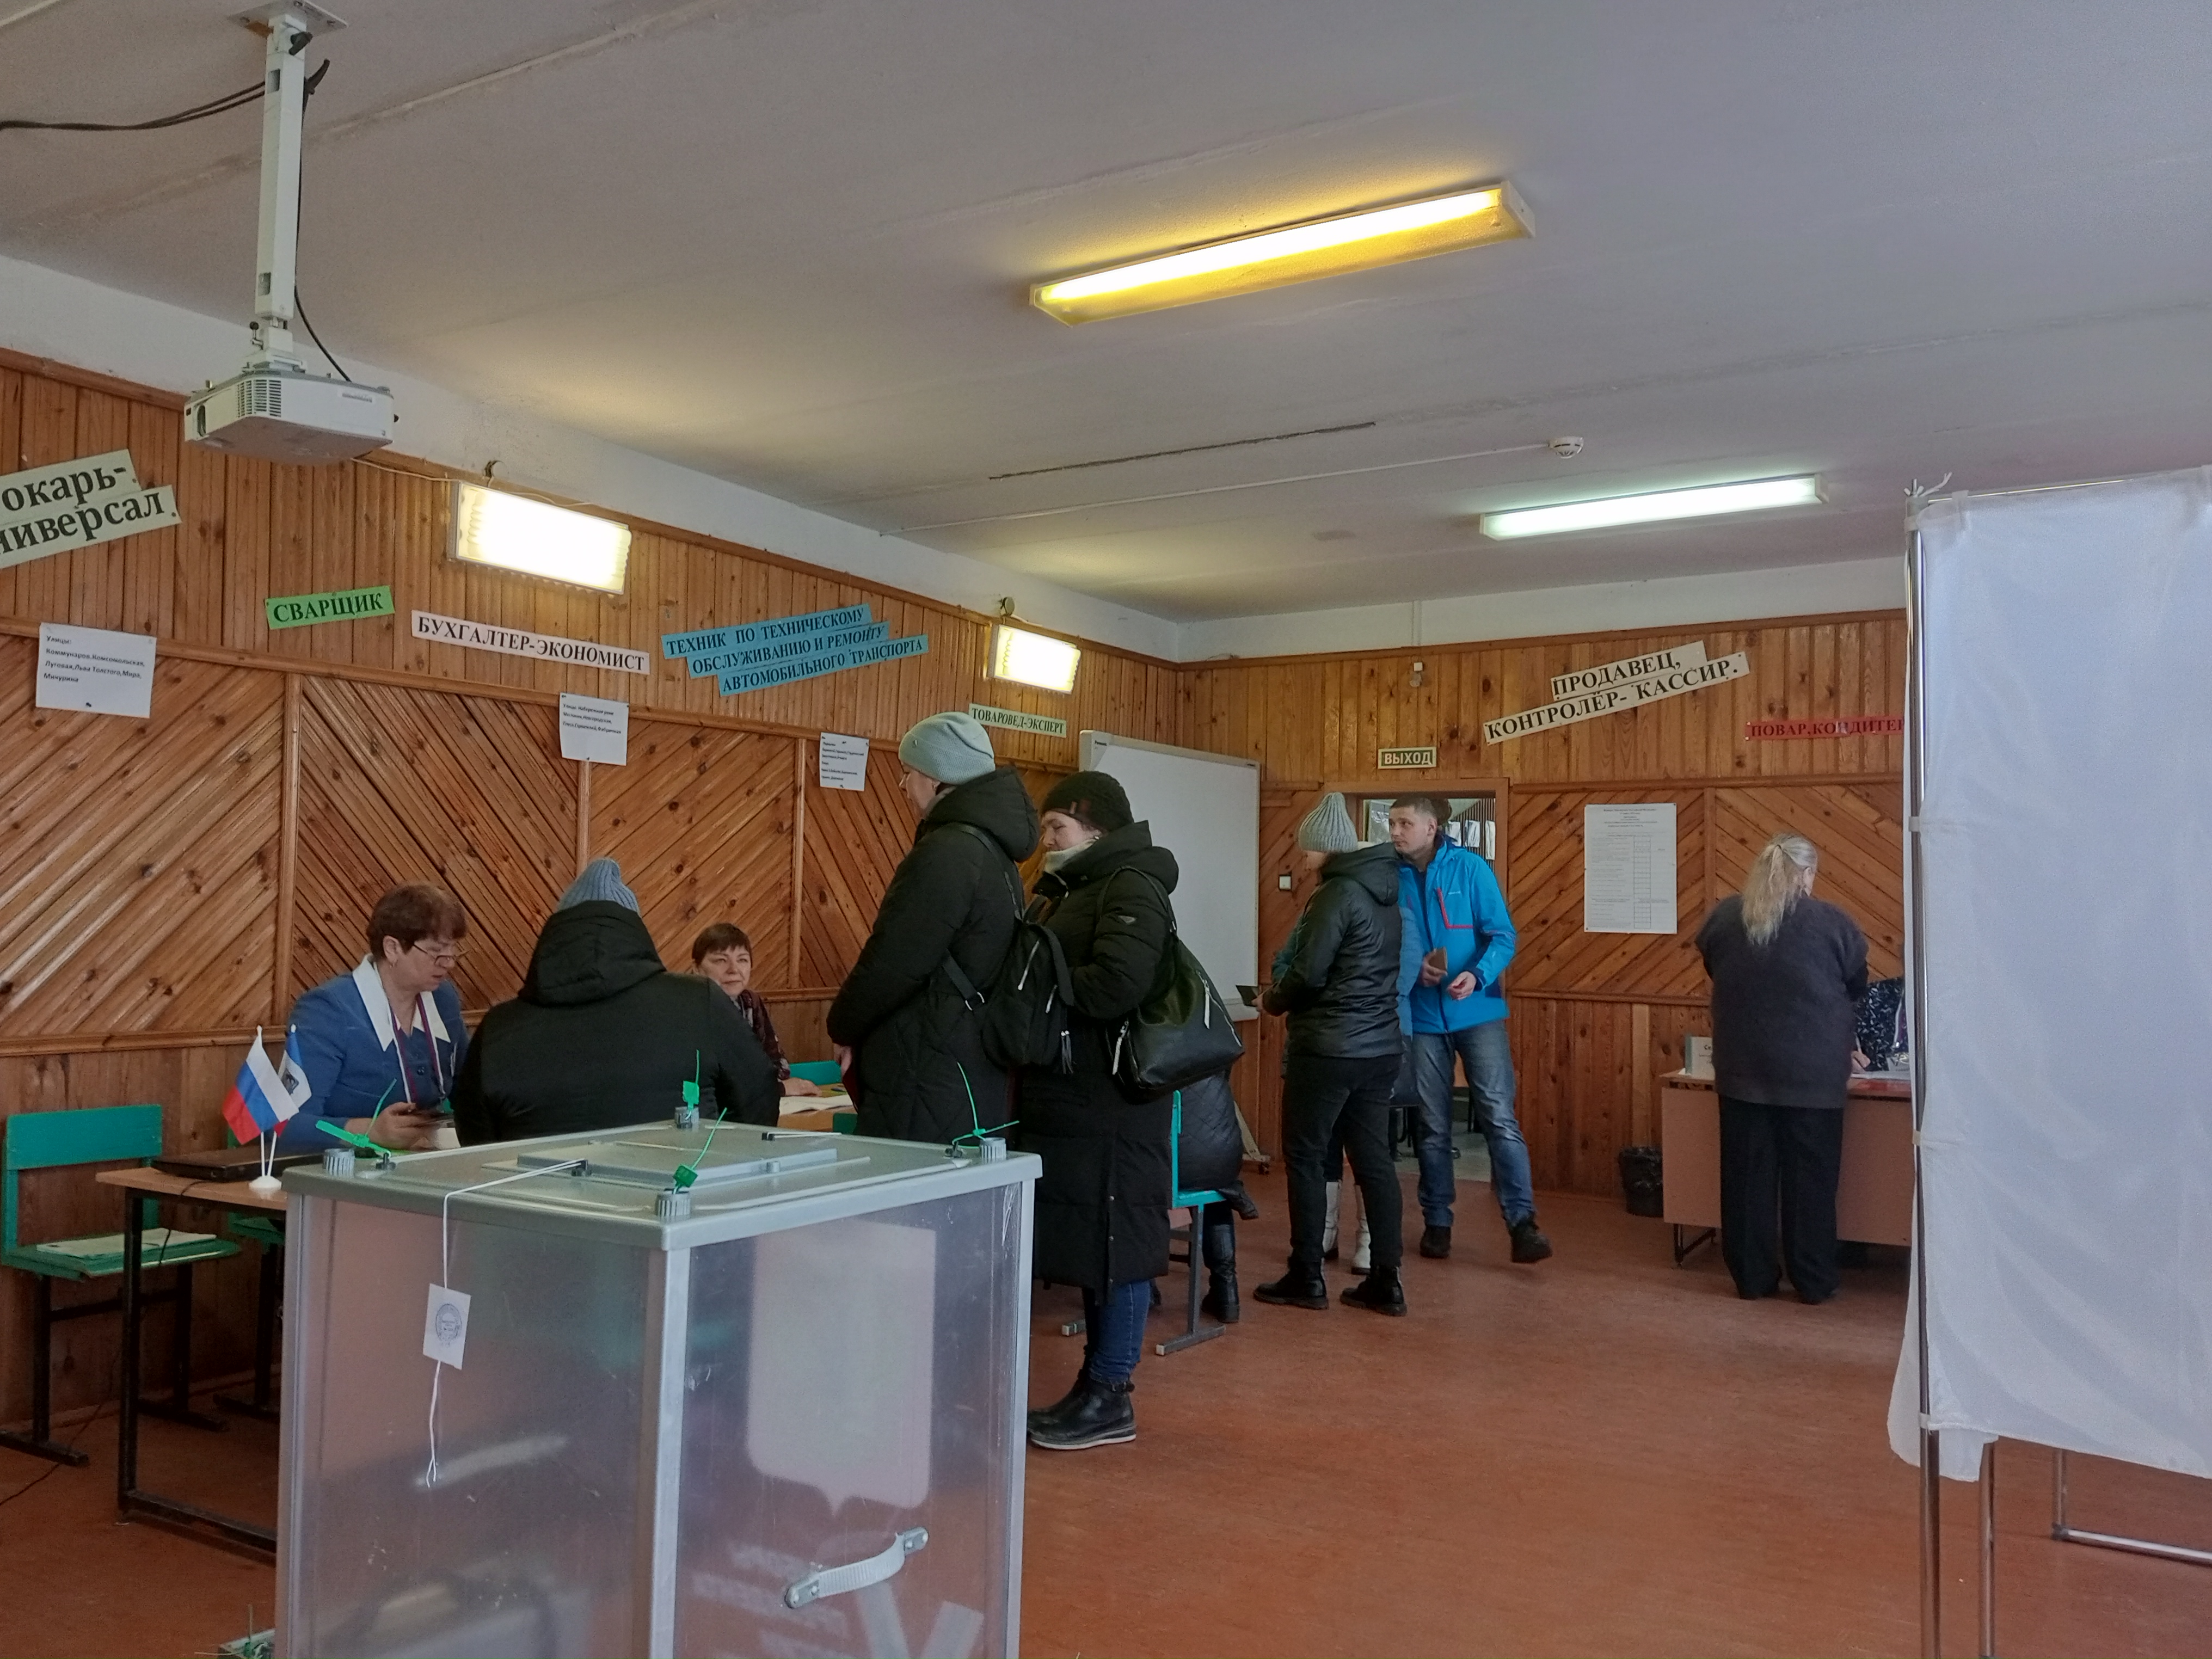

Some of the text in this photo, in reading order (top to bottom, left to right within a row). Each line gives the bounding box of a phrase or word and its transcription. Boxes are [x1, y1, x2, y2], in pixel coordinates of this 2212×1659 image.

[274, 593, 383, 622] СВАРЩИК
[419, 616, 644, 670] БУХГАЛТЕР-ЭКОНОМИСТ
[667, 608, 863, 655] ТЕХНИК ПО ТЕХНИЧЕСКОМУ
[693, 626, 884, 673] ОБСЛУЖИВАНИЮ И РЕМОНТУ
[723, 640, 922, 691] АВТОМОБИЛЬНОГО ТРАНСПОРТА
[1553, 652, 1680, 696] ПРОДАВЕЦ,
[1636, 660, 1737, 700] КАССИР.
[972, 708, 1064, 734] ТОВАРОВЕД-ЭКСПЕРТ
[1385, 751, 1433, 765] ВЫХОД
